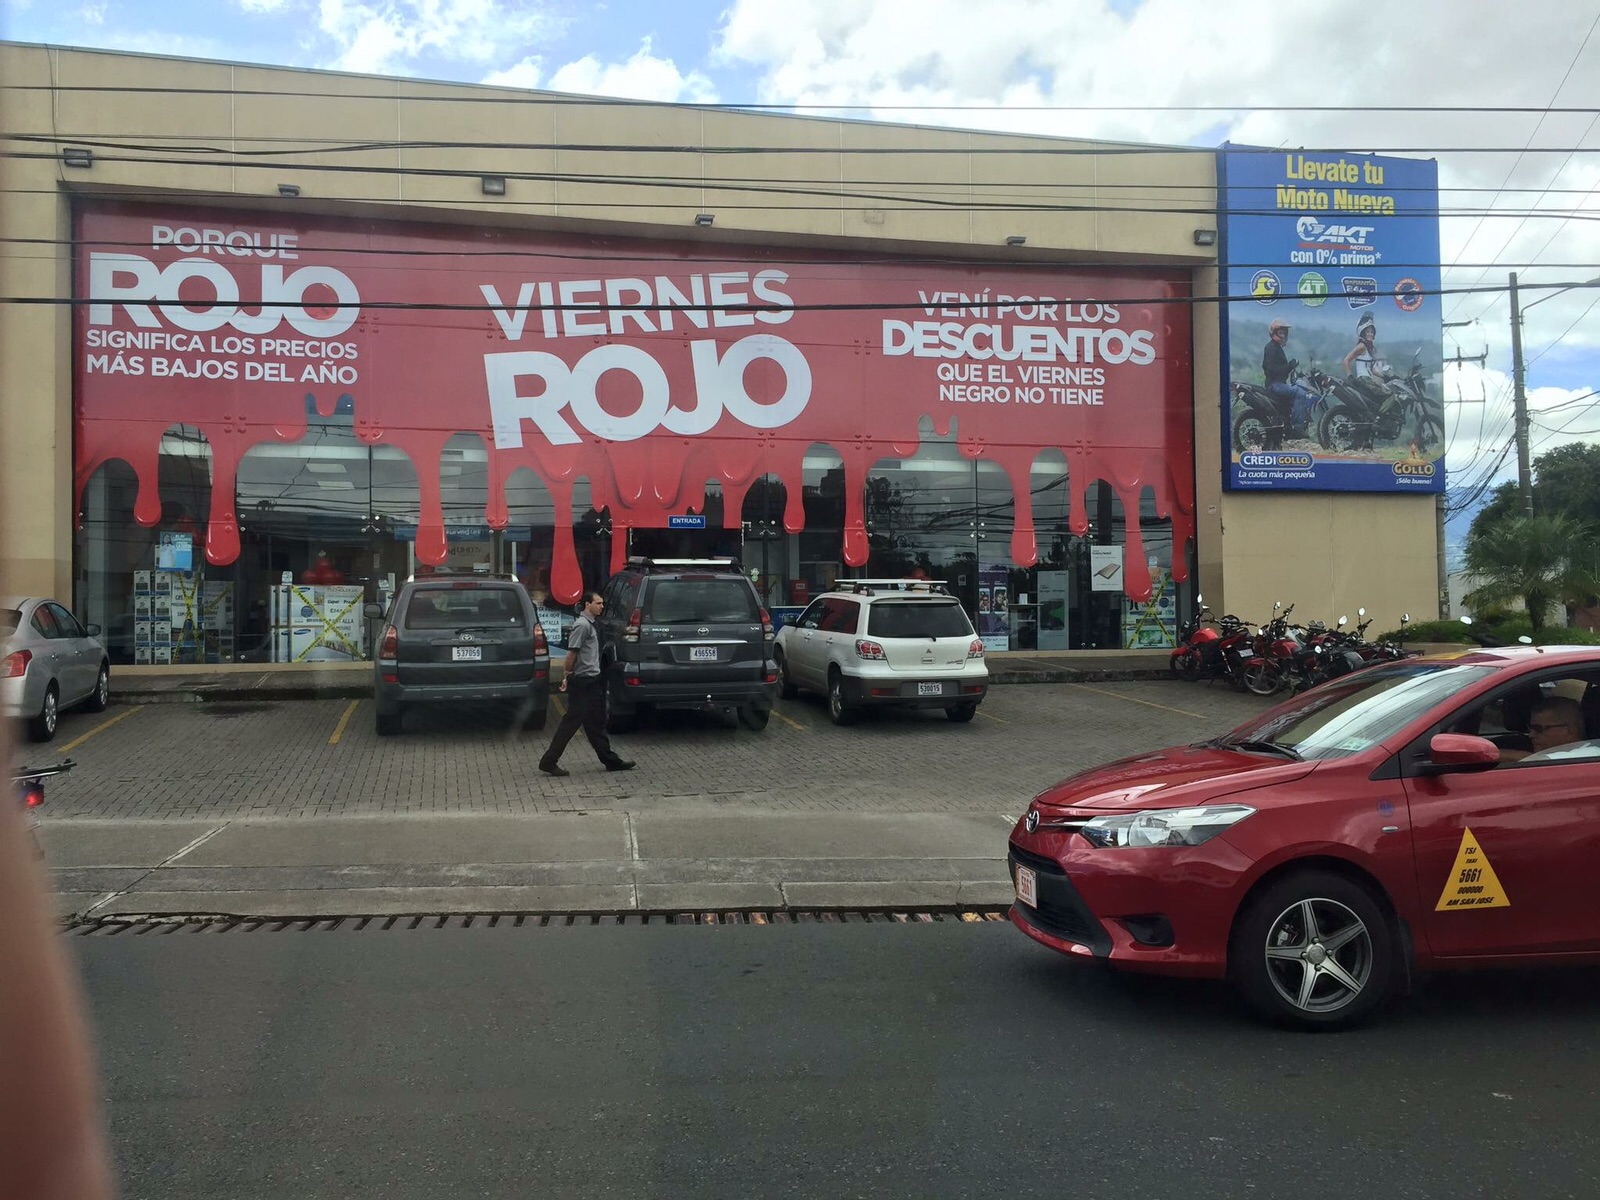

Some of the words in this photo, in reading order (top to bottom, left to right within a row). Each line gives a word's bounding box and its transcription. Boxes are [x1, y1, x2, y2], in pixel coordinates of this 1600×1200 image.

[1286, 154, 1358, 183] Llevate
[1363, 160, 1384, 185] tu
[1276, 184, 1329, 209] Moto
[1333, 188, 1395, 215] Nueva
[152, 225, 299, 260] PORQUE
[1290, 250, 1313, 263] con
[1316, 249, 1338, 264] 0%
[89, 251, 361, 338] ROJO
[478, 269, 795, 341] VIERNES
[918, 287, 991, 318] VENÍ
[997, 294, 1058, 321] POR
[1066, 298, 1120, 323] LOS
[86, 330, 205, 353] SIGNIFICA
[210, 336, 256, 355] LOS
[260, 340, 358, 360] PRECIOS
[882, 319, 1156, 365] DESCUENTOS
[86, 351, 145, 376] MÁS
[151, 357, 239, 380] BAJOS
[245, 363, 295, 382] DEL
[300, 360, 358, 385] AÑO
[936, 362, 983, 382] QUE
[988, 364, 1014, 383] EL
[1017, 365, 1105, 385] VIERNES
[483, 333, 813, 450] ROJO
[939, 384, 1010, 403] NEGRO
[1015, 388, 1045, 404] NO
[1049, 388, 1104, 405] TIENE
[1394, 463, 1434, 475] GOLLO
[1459, 868, 1482, 883] 5661
